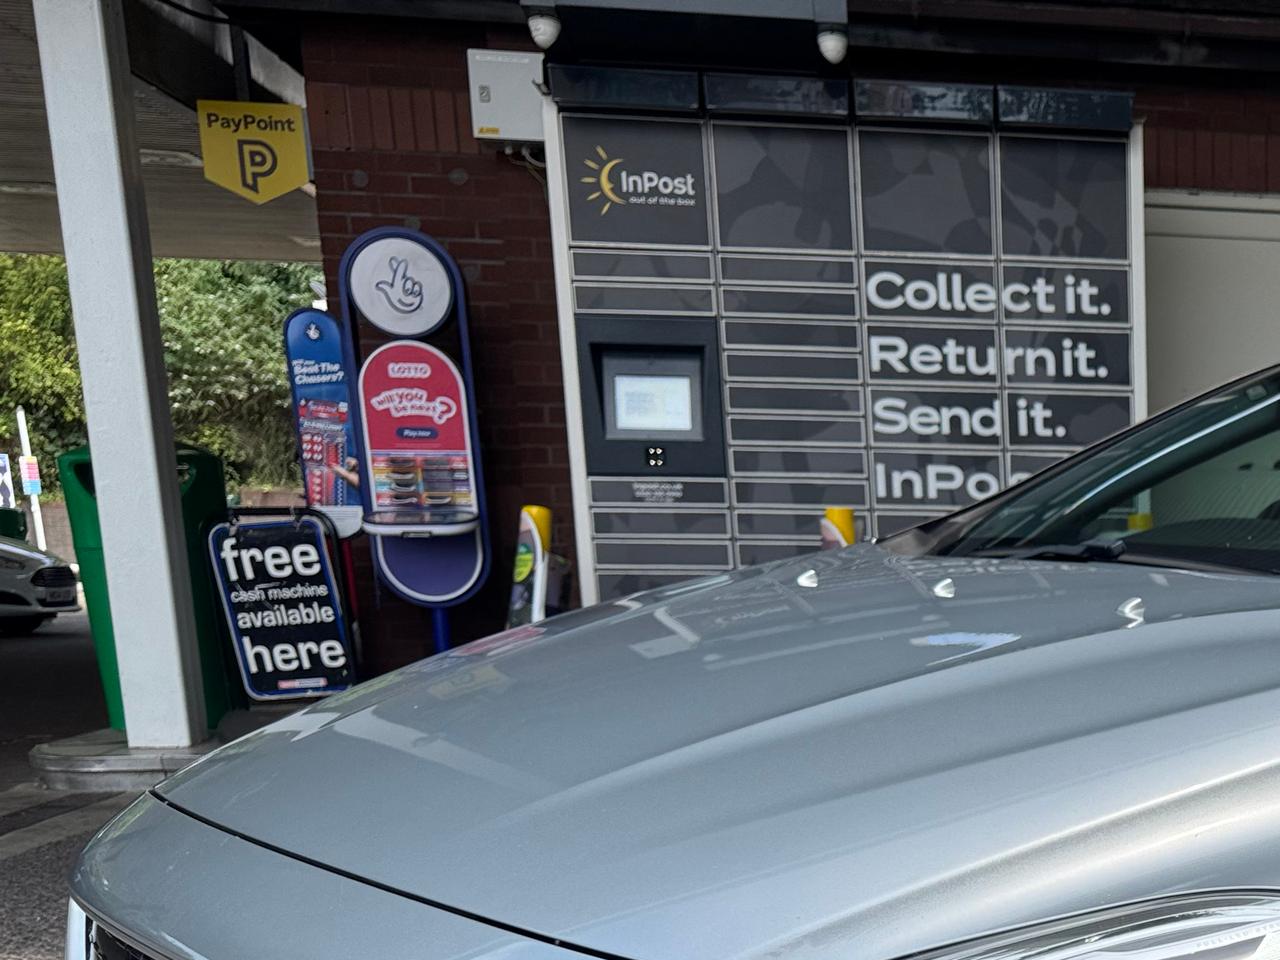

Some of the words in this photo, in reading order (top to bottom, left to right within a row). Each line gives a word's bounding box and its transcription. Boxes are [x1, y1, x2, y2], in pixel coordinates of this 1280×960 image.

[206, 112, 296, 133] PayPoint
[620, 170, 696, 196] InPost
[867, 271, 1056, 313] Collect
[1065, 274, 1111, 315] it.
[390, 365, 428, 375] LOTTO
[869, 335, 1056, 377] Return
[1062, 338, 1108, 378] it.
[873, 397, 1001, 437] Send
[1017, 398, 1067, 438] it.
[220, 537, 321, 582] free
[230, 586, 266, 602] cash
[268, 583, 329, 600] machine
[237, 601, 335, 629] available
[242, 636, 347, 674] here
